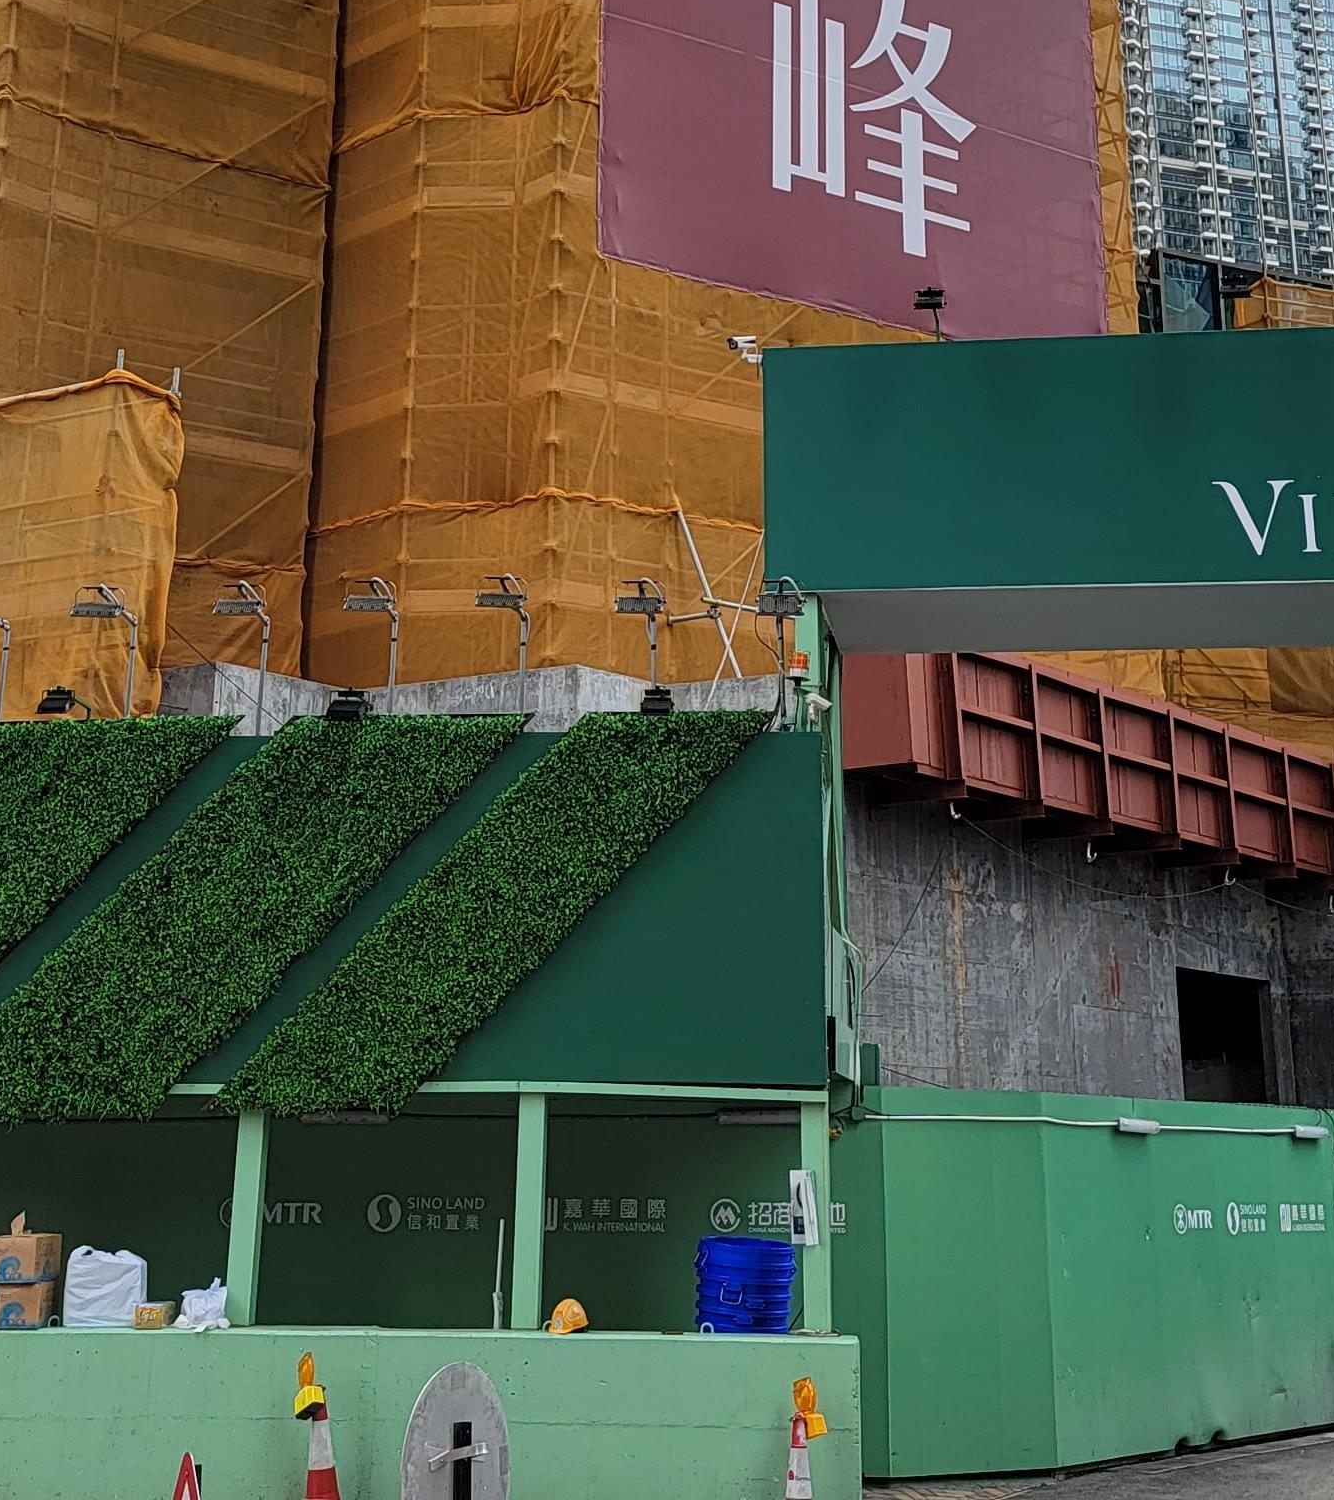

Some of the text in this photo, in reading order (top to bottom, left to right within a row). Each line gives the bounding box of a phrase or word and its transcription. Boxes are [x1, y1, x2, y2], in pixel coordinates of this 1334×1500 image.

[263, 1202, 323, 1224] MTR
[407, 1197, 485, 1210] SINO LAND
[562, 1198, 666, 1219] 嘉華國際
[407, 1213, 480, 1231] 信和置業
[572, 1222, 593, 1231] WAH
[596, 1222, 666, 1232] INTERNATIONAL
[1187, 1209, 1214, 1229] MTR
